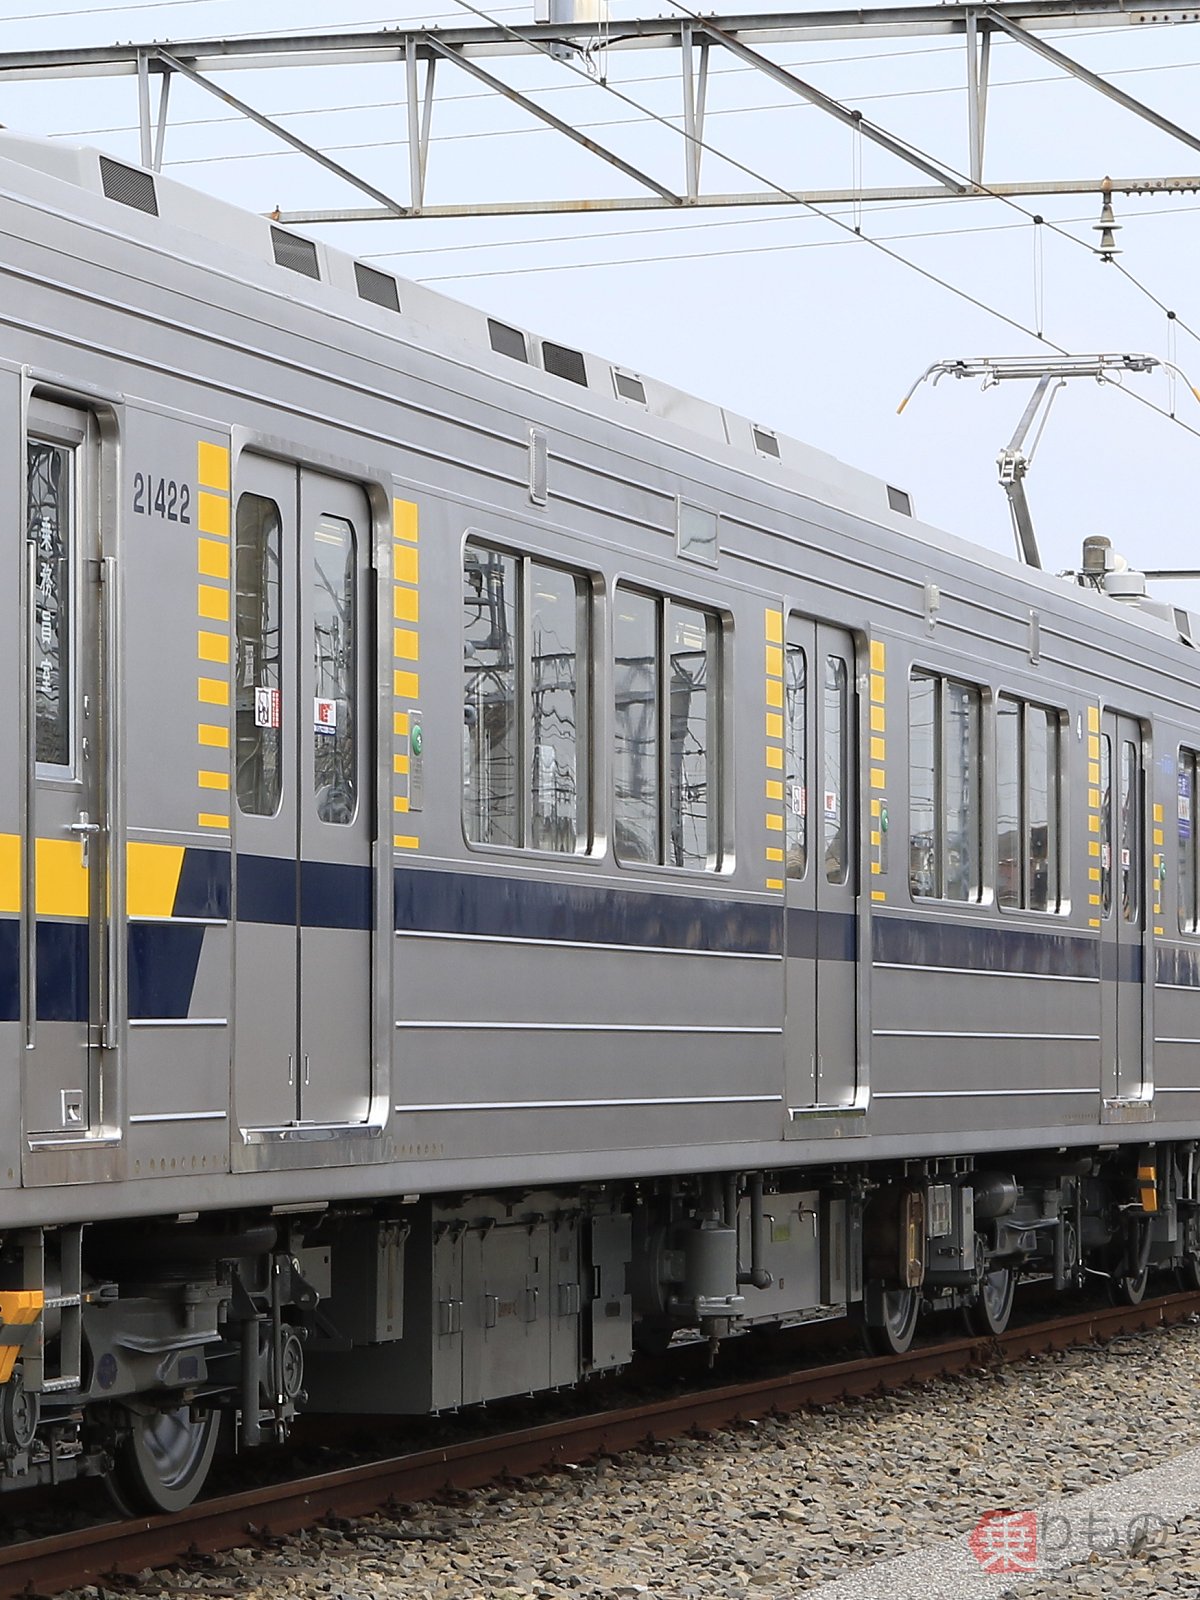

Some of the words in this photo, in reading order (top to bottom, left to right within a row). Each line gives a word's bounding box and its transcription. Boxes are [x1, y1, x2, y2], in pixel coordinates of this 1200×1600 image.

[133, 472, 191, 524] 21422
[40, 516, 54, 692] 乗務員室
